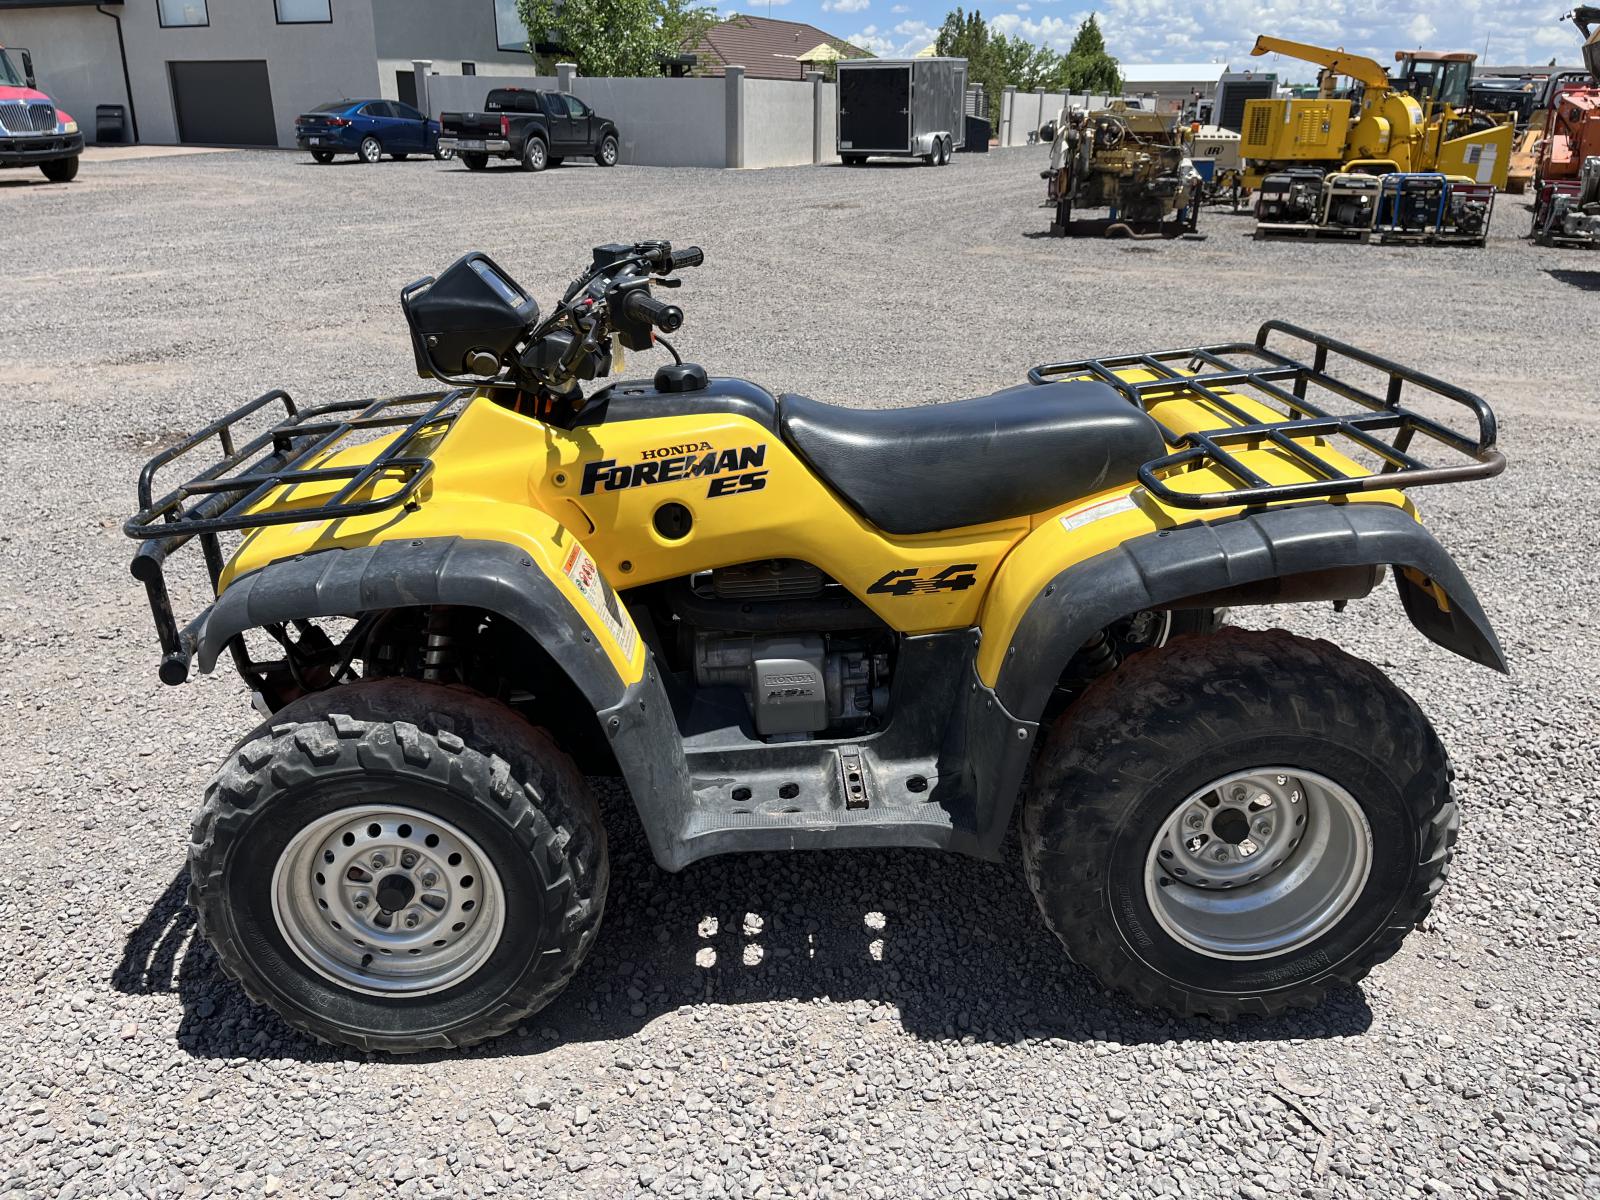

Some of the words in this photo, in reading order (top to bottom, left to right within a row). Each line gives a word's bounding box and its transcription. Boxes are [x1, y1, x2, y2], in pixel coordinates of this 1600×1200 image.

[641, 441, 714, 460] HONDA
[580, 444, 766, 496] FOREMAN
[706, 470, 769, 498] ES
